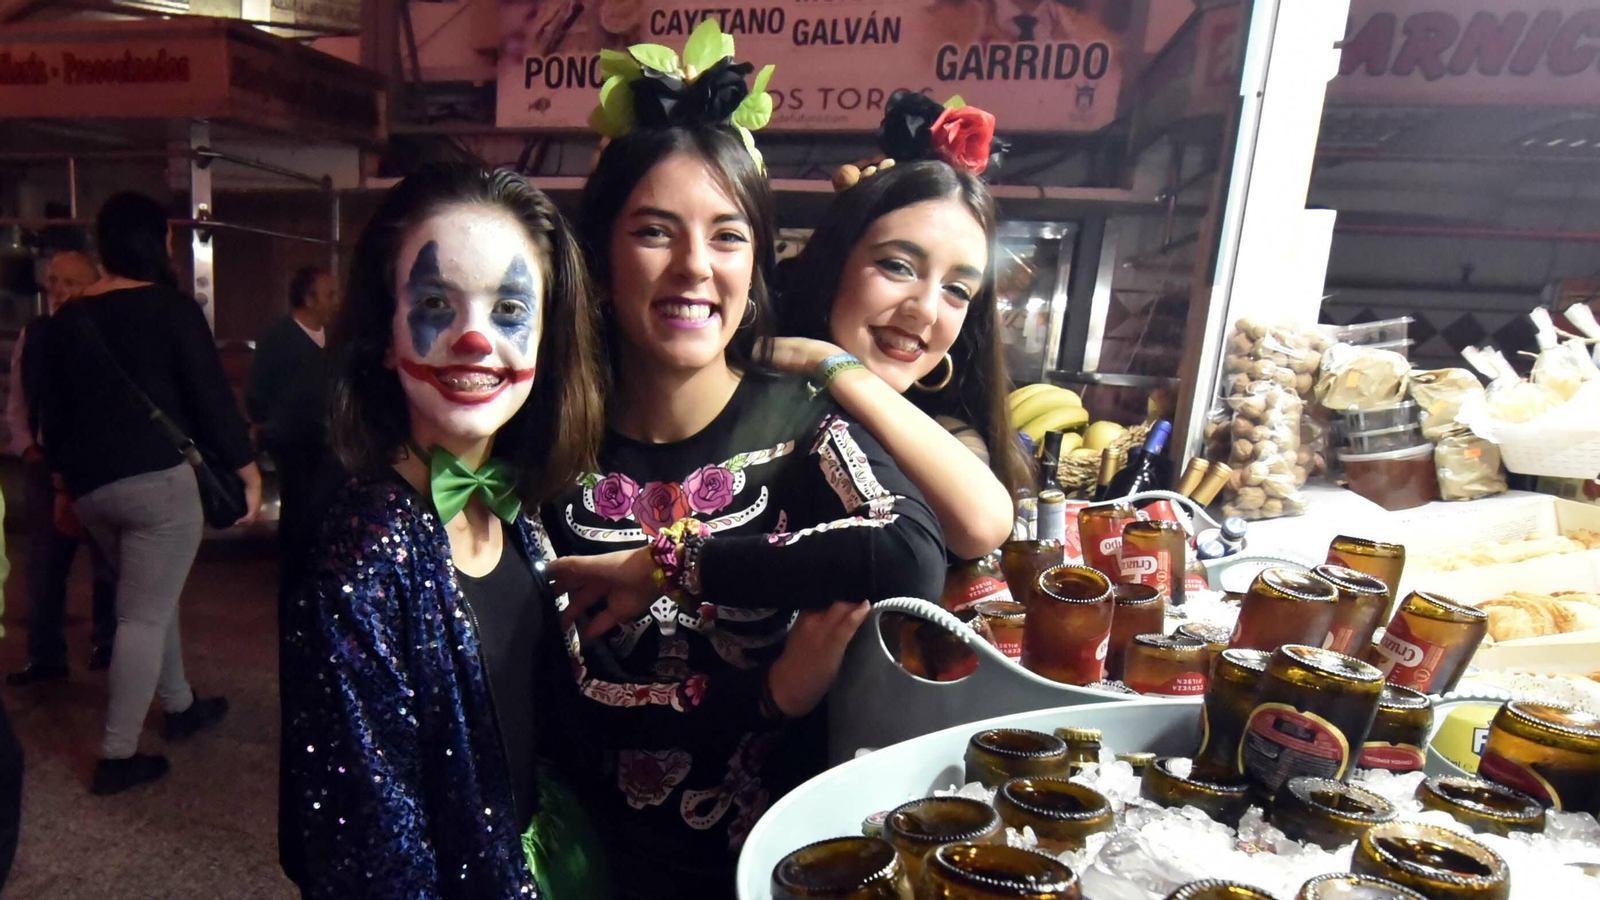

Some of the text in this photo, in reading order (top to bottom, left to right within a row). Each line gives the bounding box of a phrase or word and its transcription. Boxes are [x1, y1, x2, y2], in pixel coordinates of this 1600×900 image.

[650, 7, 785, 36] CAYETANO
[792, 11, 901, 46] GALVÁN
[936, 42, 1109, 81] GARRIDO
[1340, 8, 1600, 81] ARNIC
[818, 87, 933, 111] TOR
